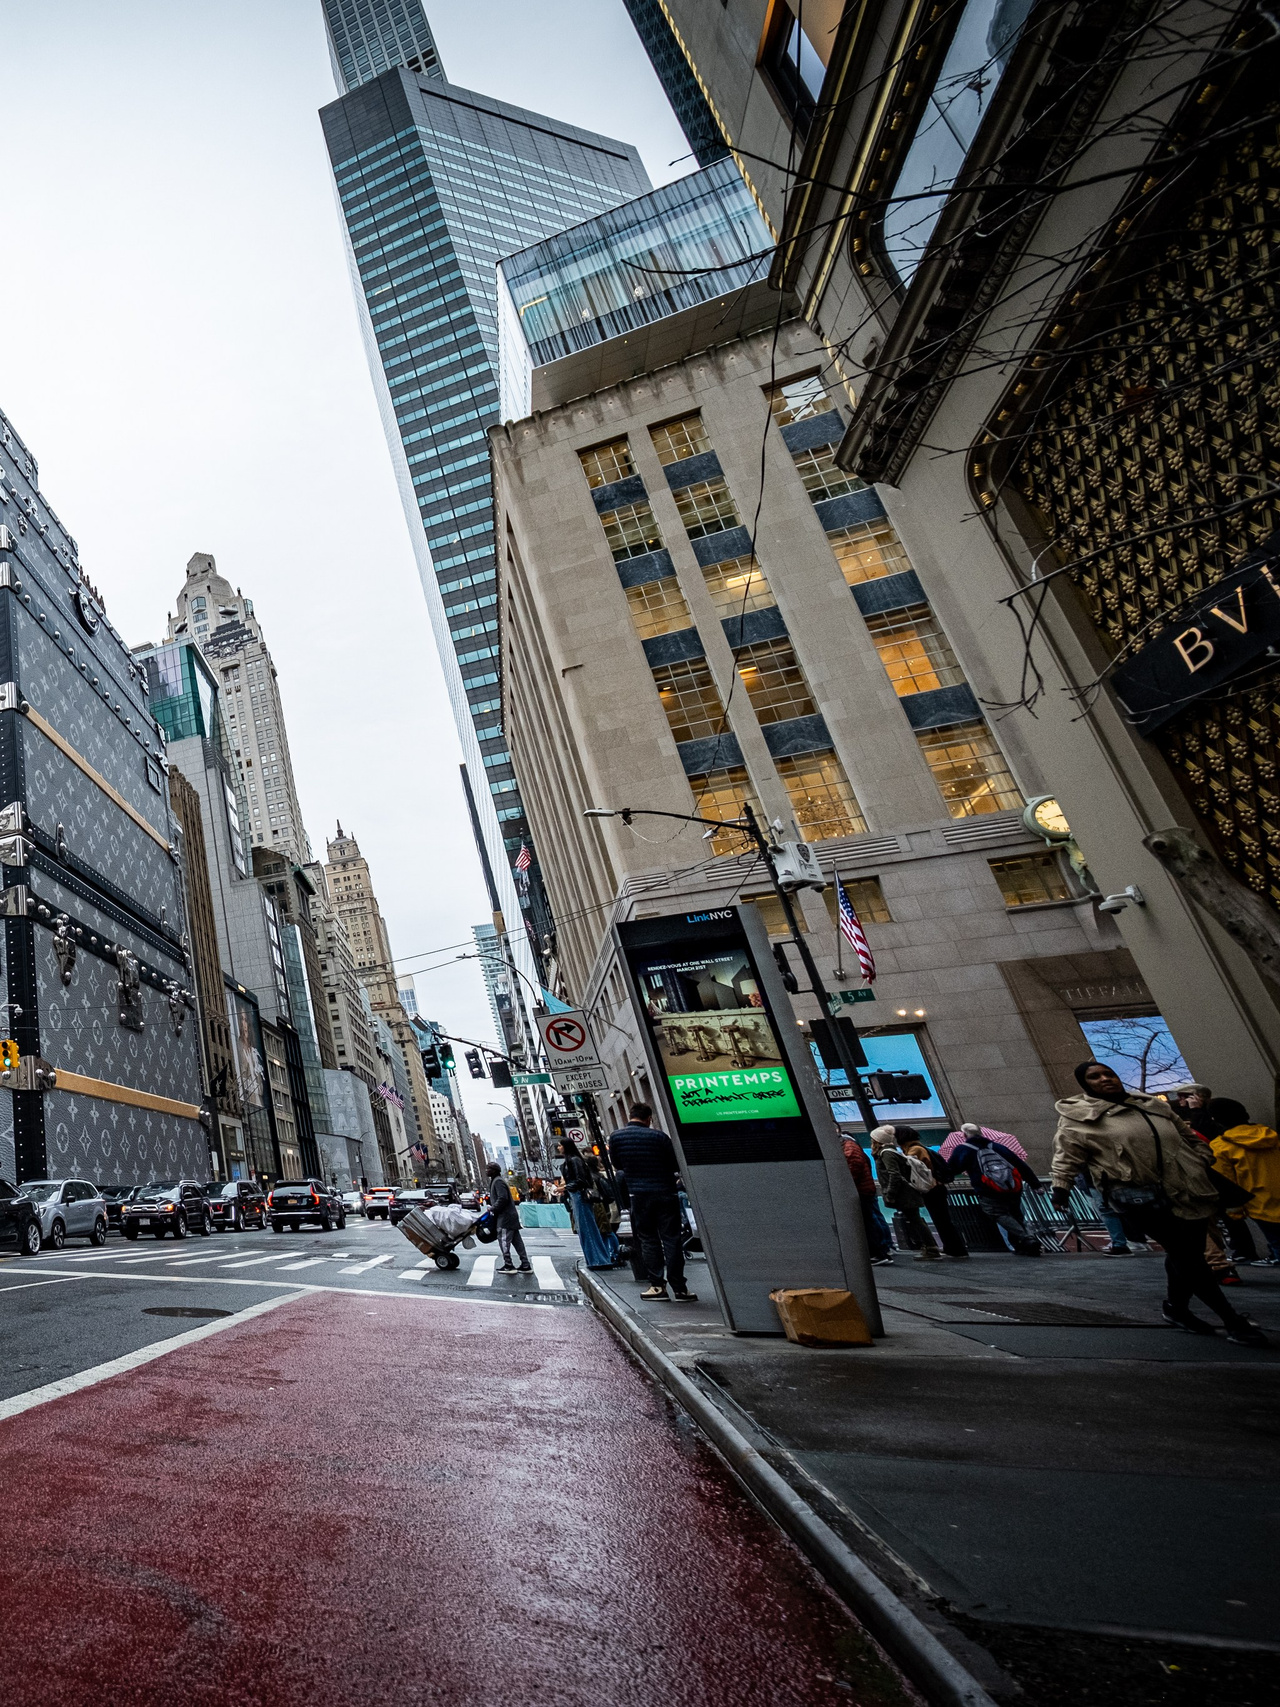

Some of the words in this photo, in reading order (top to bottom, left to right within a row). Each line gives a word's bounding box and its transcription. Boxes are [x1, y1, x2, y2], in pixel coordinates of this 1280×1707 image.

[686, 910, 733, 924] LinkNYC
[847, 991, 855, 1002] 5
[565, 1072, 592, 1082] EXCEPT
[674, 1071, 782, 1090] PRINTEMPS
[560, 1083, 576, 1091] MTA
[578, 1080, 603, 1090] BUSES
[831, 1089, 851, 1098] ONE
